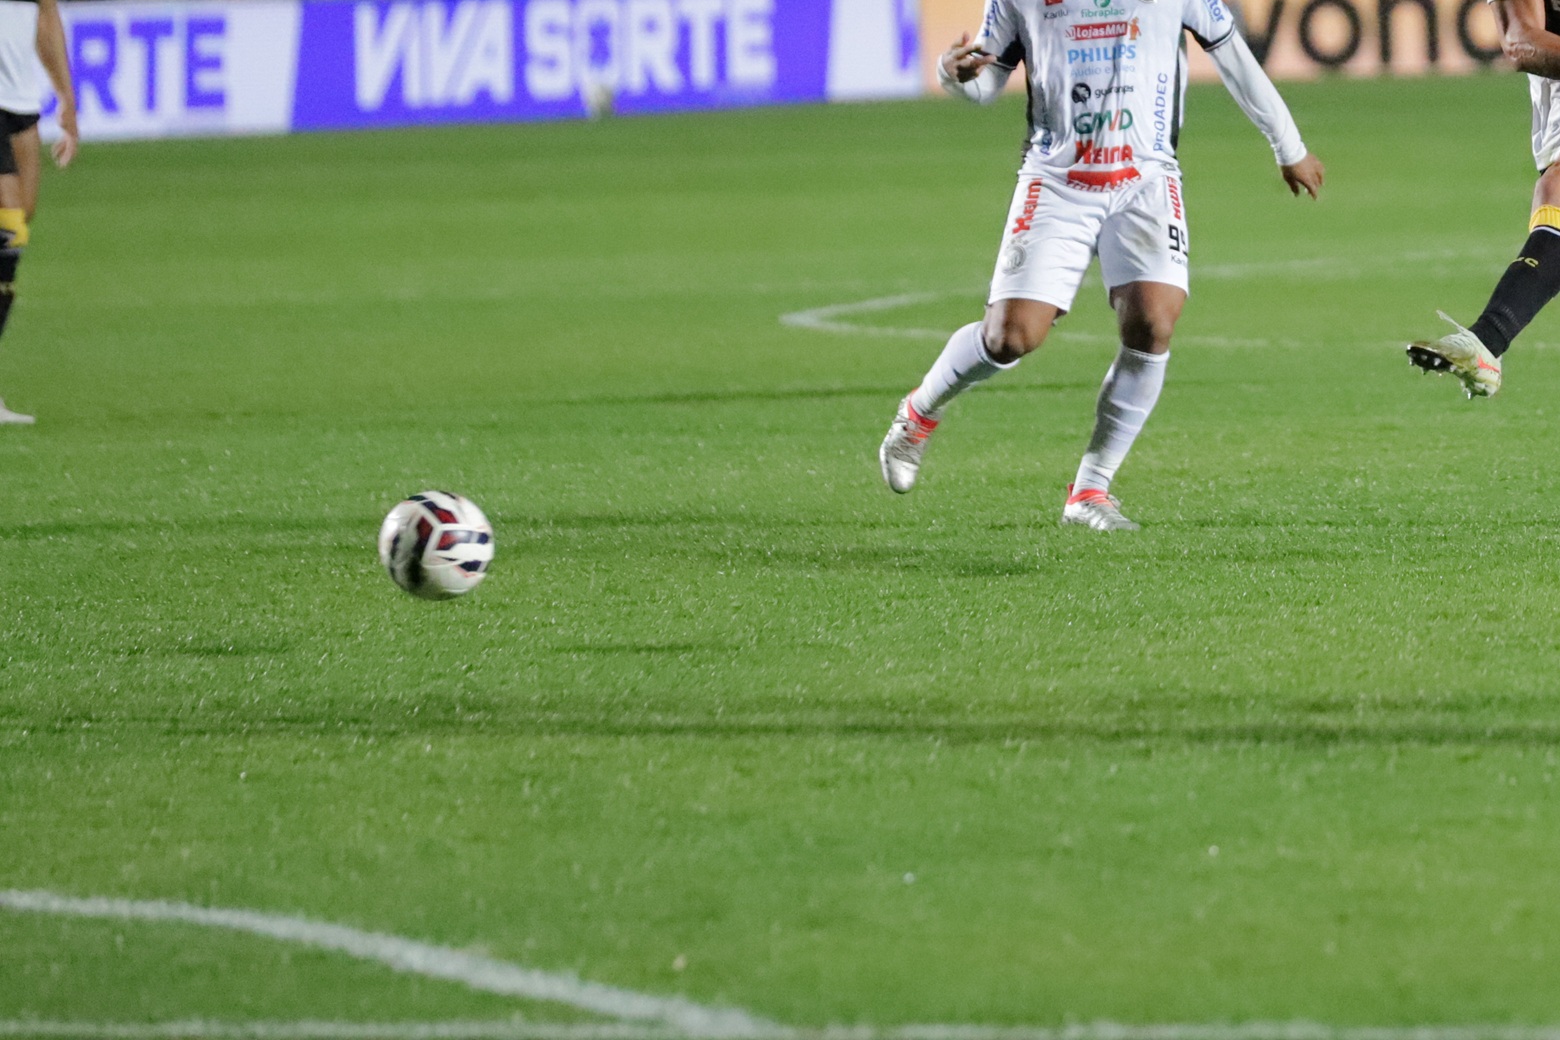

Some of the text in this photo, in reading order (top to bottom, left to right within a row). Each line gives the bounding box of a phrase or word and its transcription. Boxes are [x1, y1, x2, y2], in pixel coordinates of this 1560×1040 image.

[41, 16, 227, 117] RTE
[1068, 44, 1136, 65] PHILIPS
[1153, 72, 1168, 152] PROADEC
